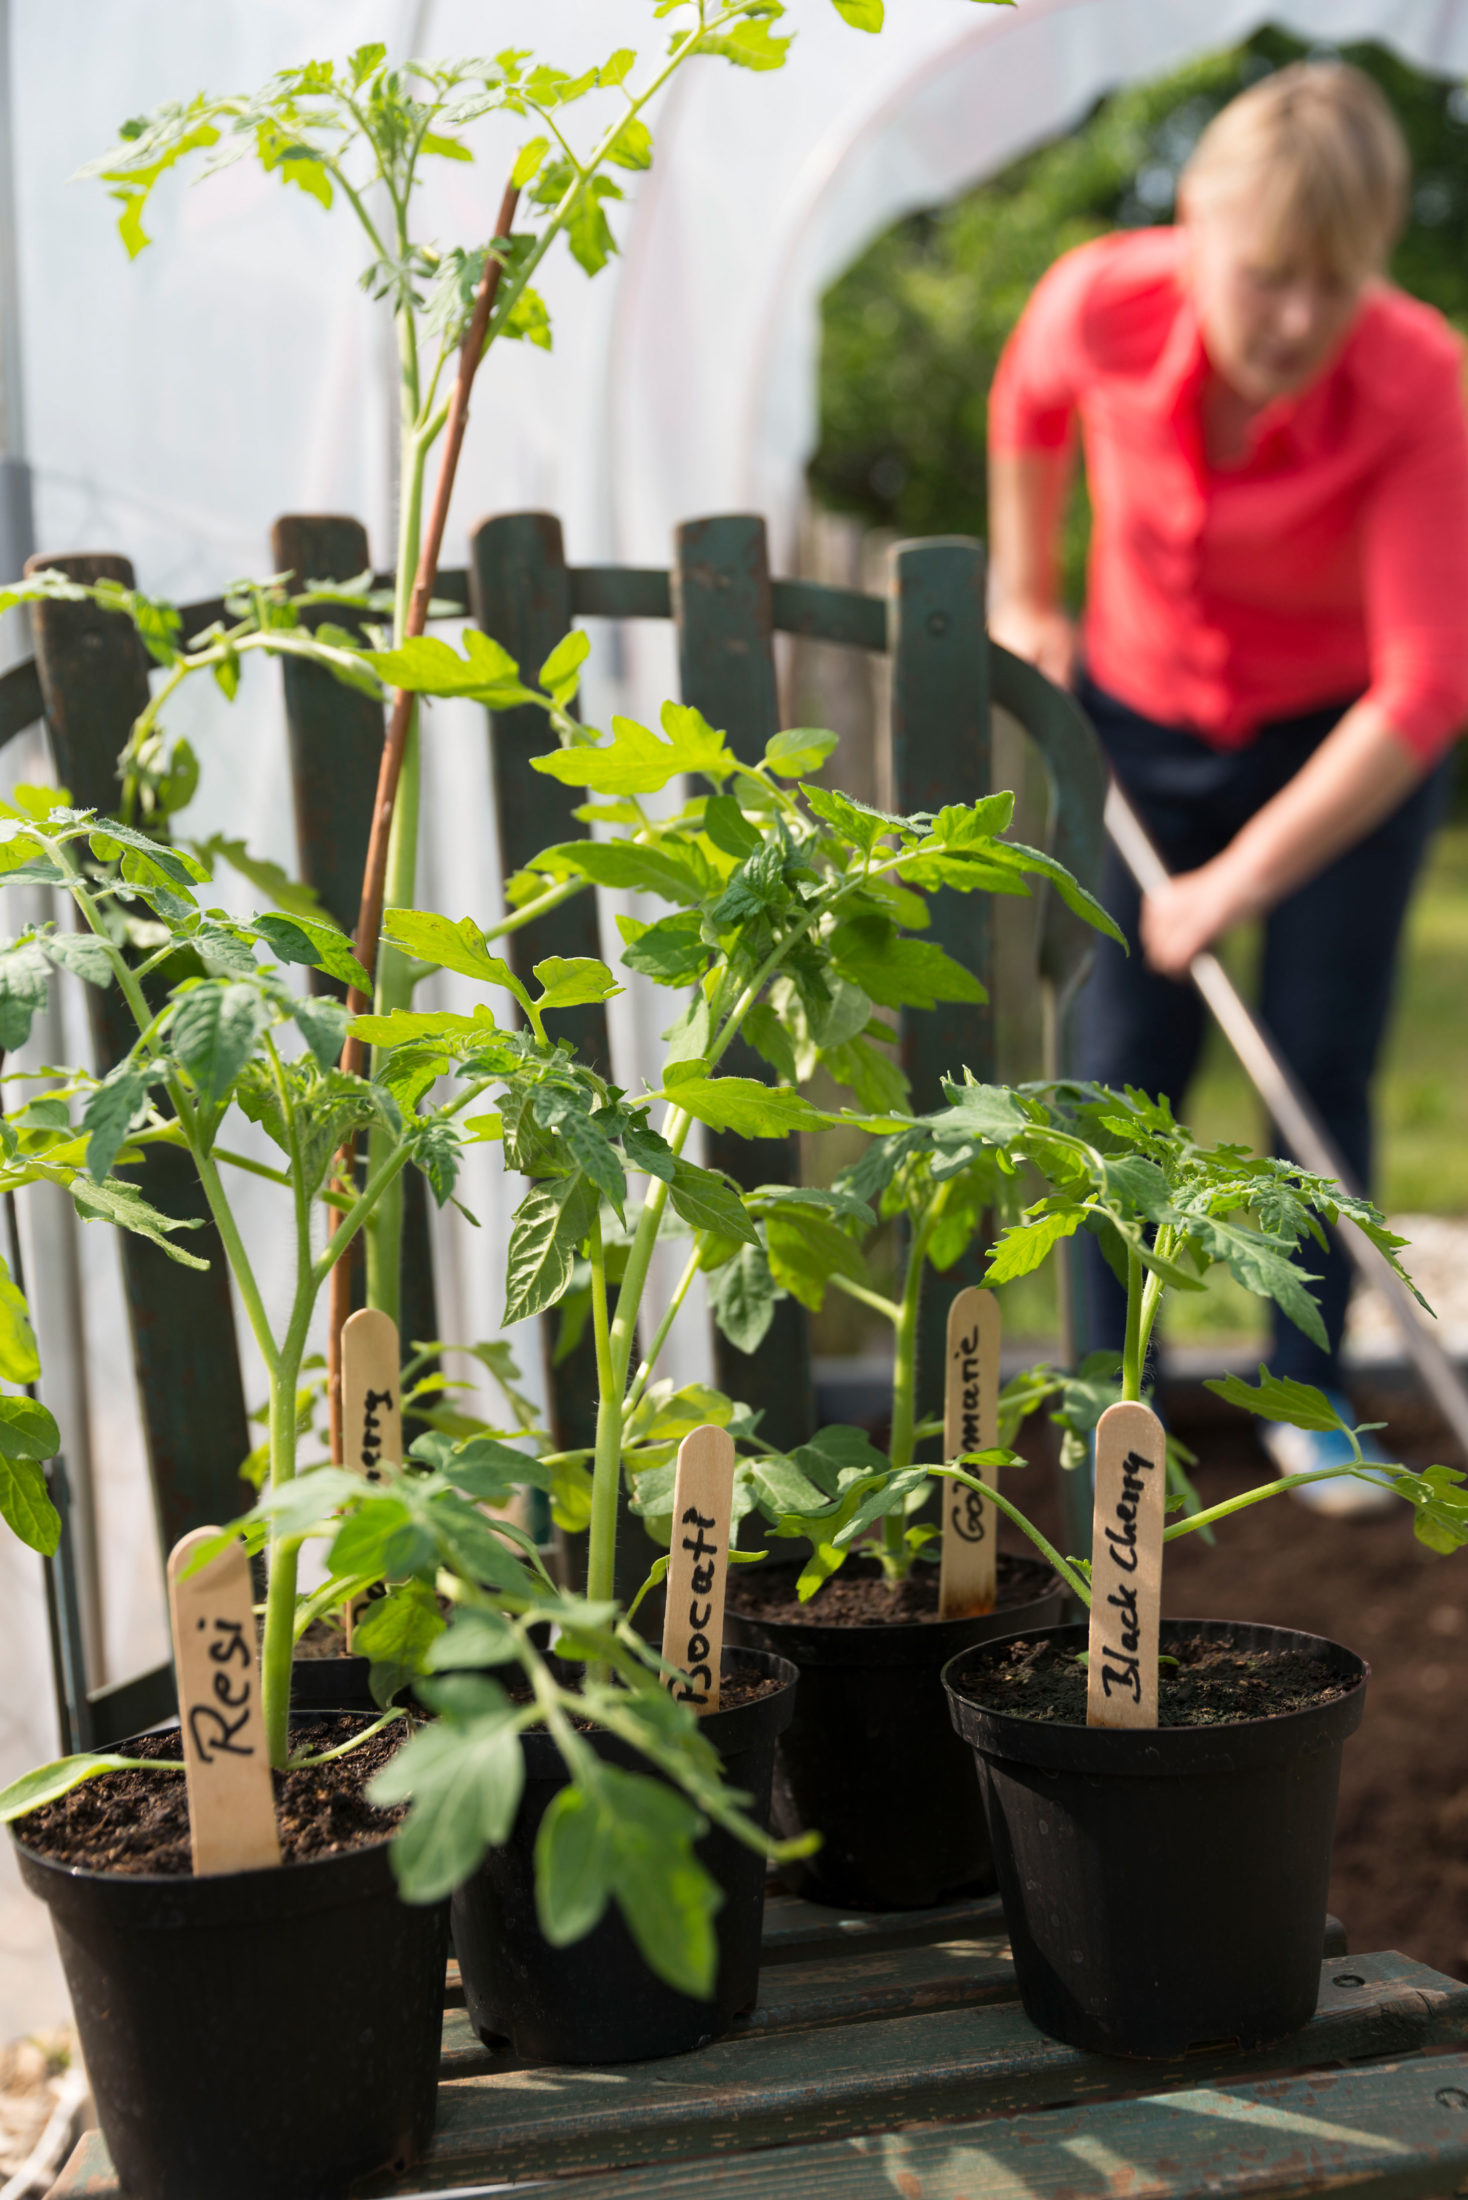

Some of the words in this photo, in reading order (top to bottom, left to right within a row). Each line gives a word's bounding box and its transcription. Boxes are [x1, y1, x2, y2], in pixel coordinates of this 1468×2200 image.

[1105, 1451, 1155, 1572] Cherry
[189, 1617, 254, 1764] Resi
[1101, 1584, 1140, 1704] Black
